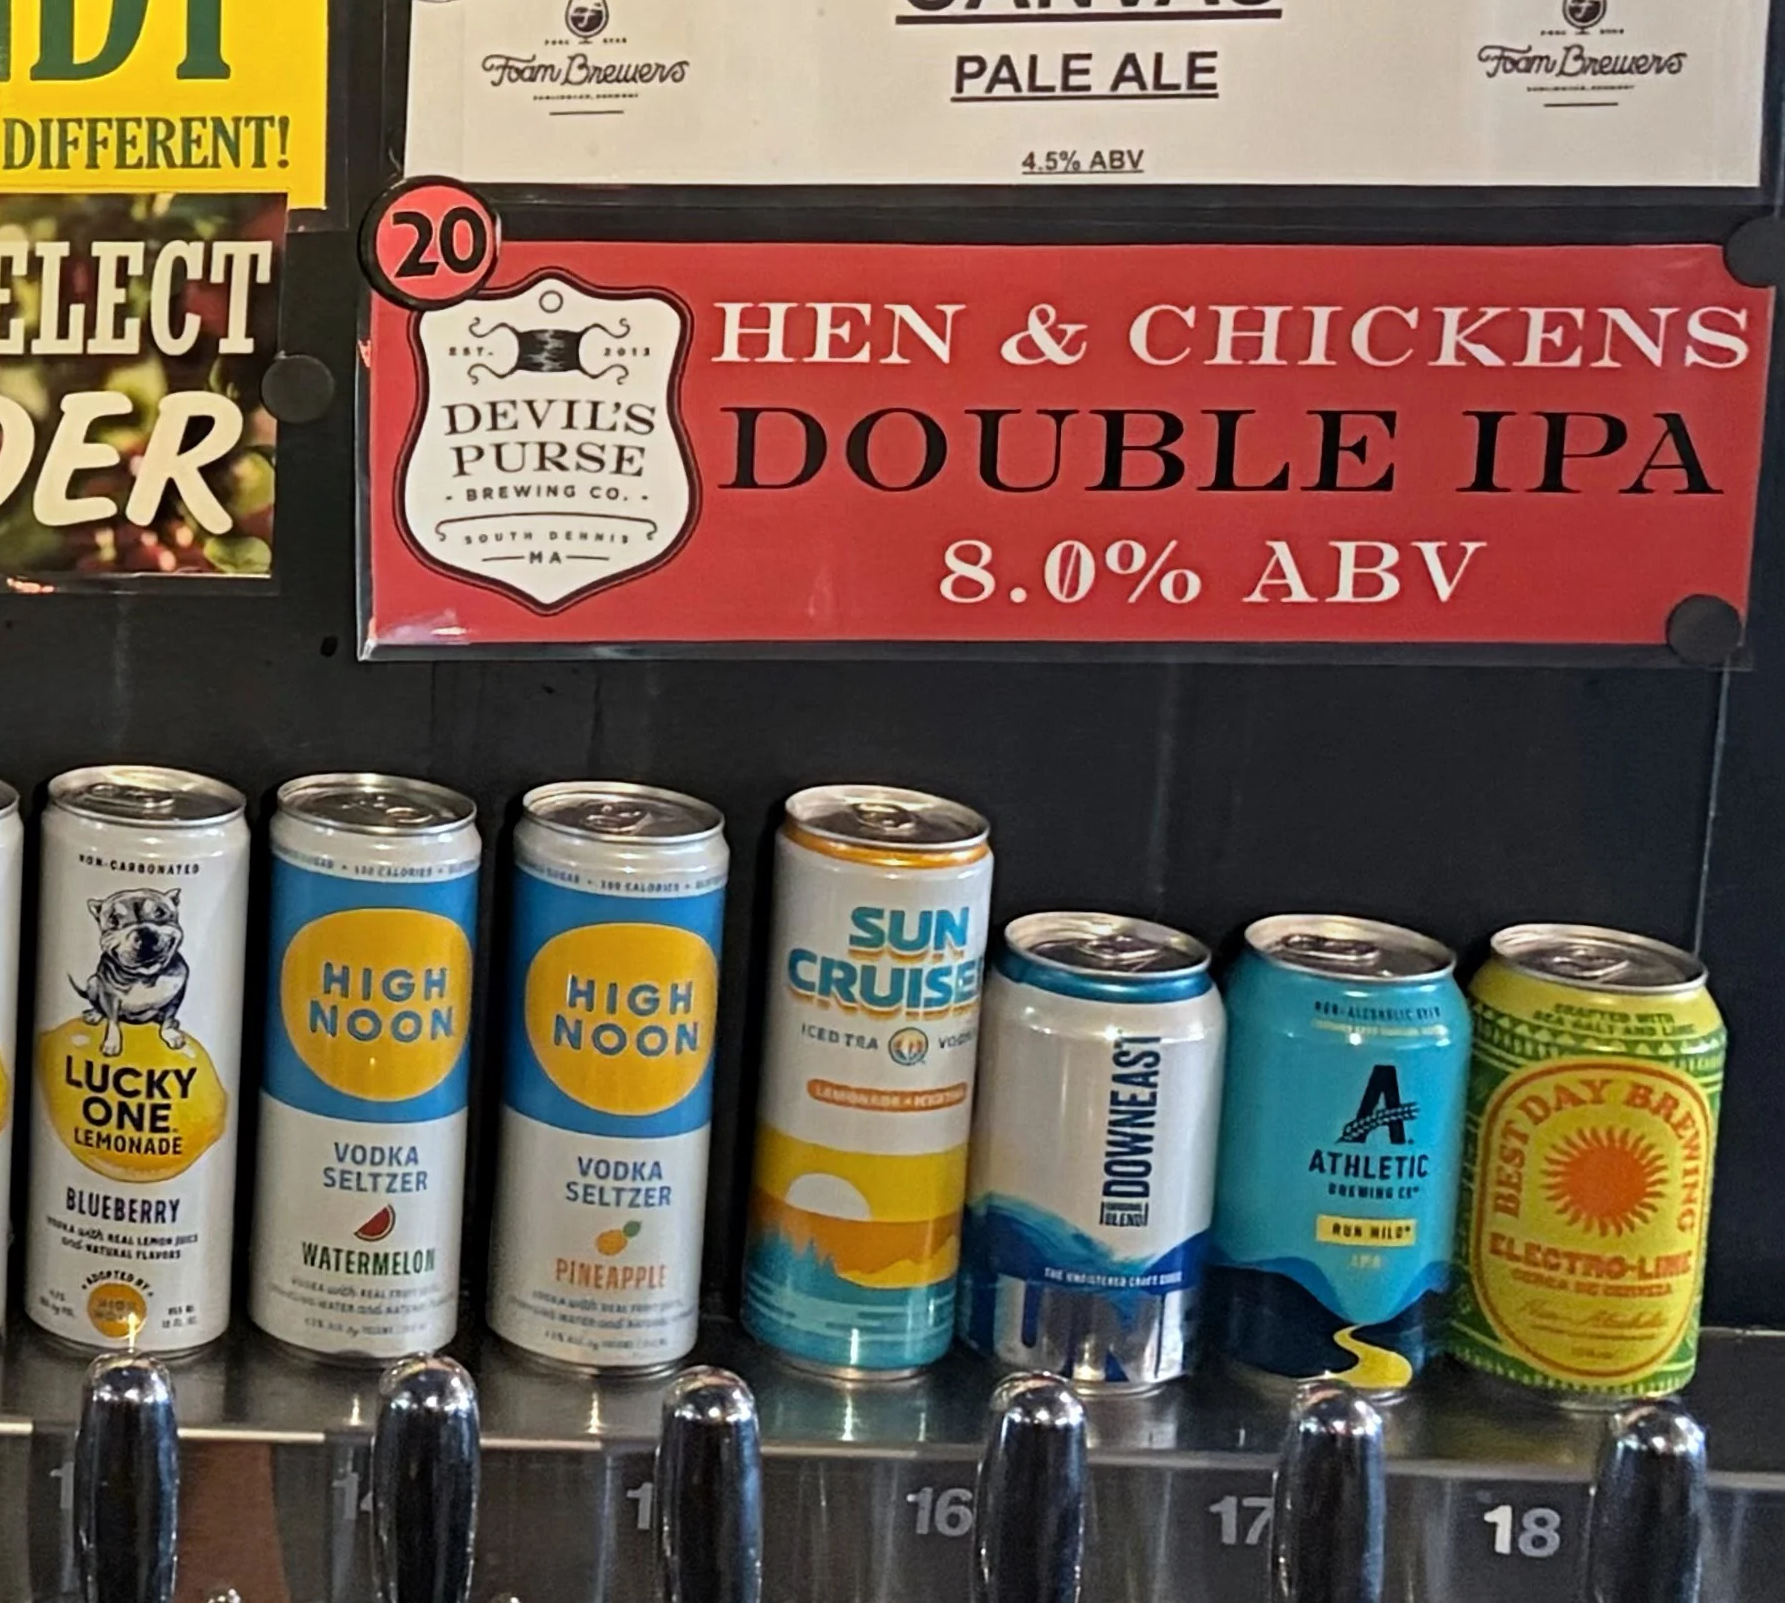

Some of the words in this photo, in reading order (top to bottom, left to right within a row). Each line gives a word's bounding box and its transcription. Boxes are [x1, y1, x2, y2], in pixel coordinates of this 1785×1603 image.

[481, 53, 560, 90] Foam
[565, 52, 689, 88] Brewers
[953, 53, 1094, 93] PALE
[1111, 51, 1219, 92] ALE
[3, 115, 290, 172] DIFFERENT!
[1022, 148, 1081, 173] 4.5%
[1089, 148, 1144, 172] ABV
[393, 208, 487, 278] 20
[712, 299, 953, 368] HEN
[1000, 304, 1090, 369] &
[1129, 305, 1751, 369] CHICKENS
[442, 399, 658, 438] DEVIL'S
[451, 441, 647, 479] PURSE
[720, 402, 1402, 498] DOUBLE
[1460, 409, 1723, 497] IPA
[939, 537, 1204, 606] 8.0%
[1244, 539, 1488, 605] ABV
[849, 906, 970, 953] SUN
[323, 962, 448, 1002] HIGH
[308, 1000, 455, 1043] NOON
[1103, 1035, 1161, 1197] DOWNEAST
[1308, 1149, 1428, 1180] ATHLETIC
[66, 1187, 180, 1224] BLUEBERRY
[302, 1241, 436, 1276] WATERMELON
[556, 1257, 667, 1290] PINEAPPLE
[906, 1487, 975, 1536] 16
[1484, 1506, 1561, 1556] 18
